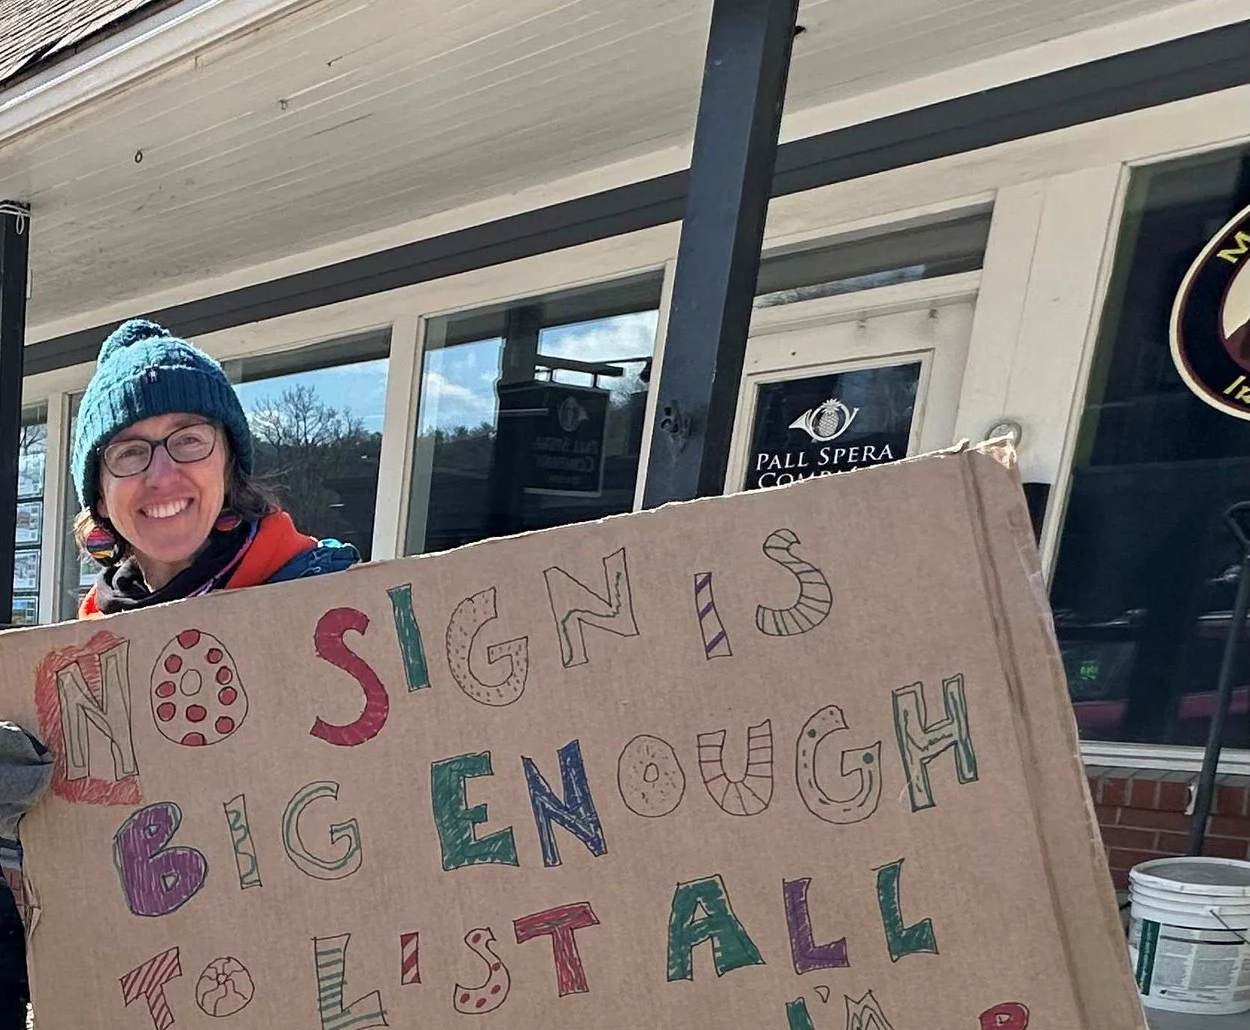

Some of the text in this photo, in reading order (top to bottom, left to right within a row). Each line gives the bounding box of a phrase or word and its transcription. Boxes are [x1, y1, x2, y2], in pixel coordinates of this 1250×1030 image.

[755, 443, 894, 471] PALL SPERA
[53, 528, 833, 785] NO SIGN IS
[113, 673, 979, 917] BIG ENOUGH
[666, 858, 939, 982] ALL
